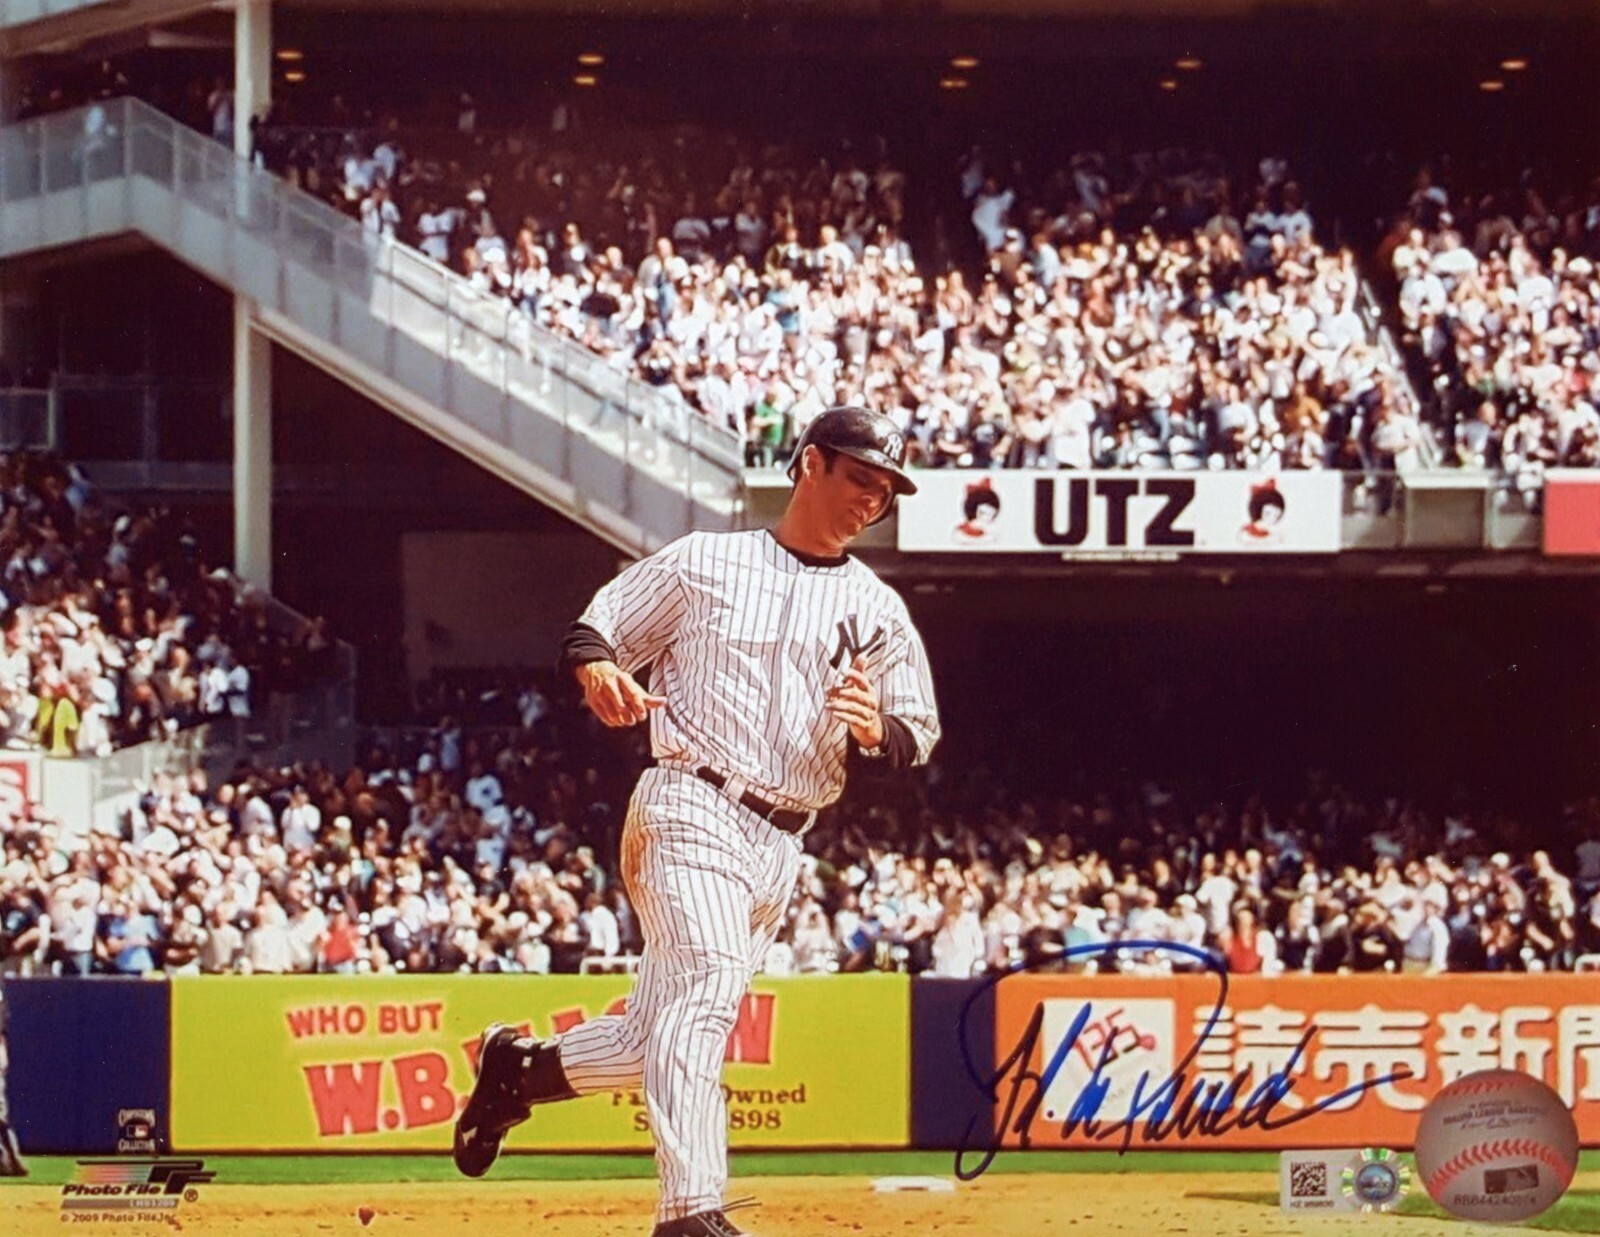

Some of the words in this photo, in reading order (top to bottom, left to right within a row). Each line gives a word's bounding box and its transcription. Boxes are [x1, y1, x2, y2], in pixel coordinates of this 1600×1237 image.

[1034, 477, 1196, 547] UTZ
[286, 1004, 367, 1038] WHO
[378, 1002, 443, 1035] BUT
[729, 1108, 782, 1131] 898
